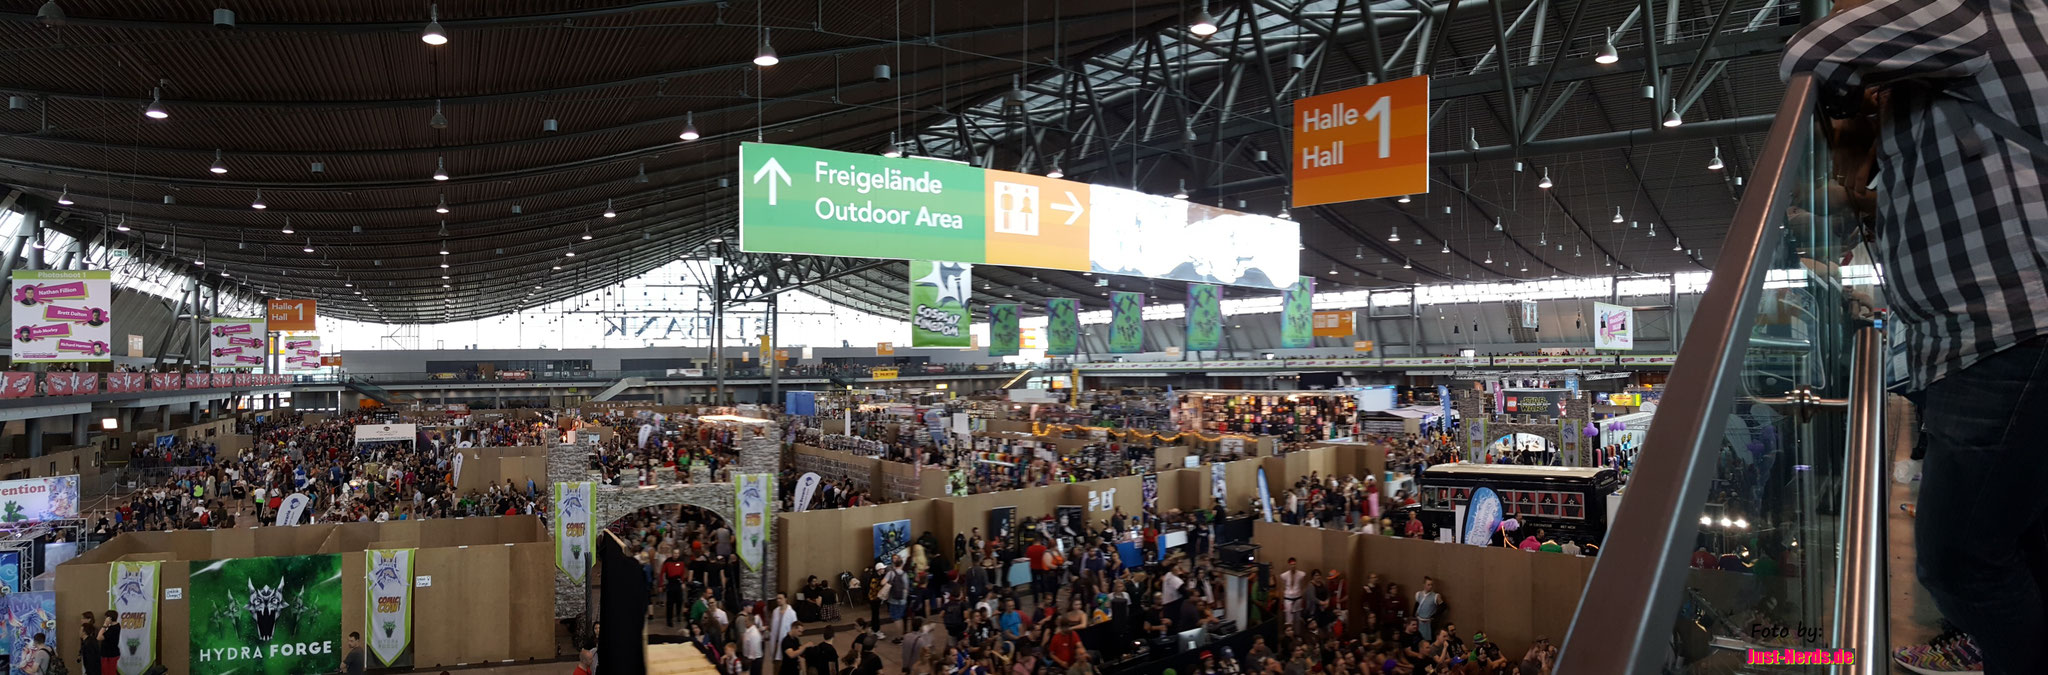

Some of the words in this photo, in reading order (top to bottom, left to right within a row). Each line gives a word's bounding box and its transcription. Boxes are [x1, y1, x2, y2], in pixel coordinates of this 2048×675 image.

[1303, 103, 1359, 133] Halle
[1363, 95, 1391, 159] 1
[1302, 140, 1344, 170] Hall
[814, 160, 943, 198] Freigelände
[814, 196, 911, 227] Outdoor
[915, 206, 964, 231] Area
[70, 310, 88, 318] Dalton
[271, 302, 293, 312] Halle
[271, 312, 288, 322] Hall
[293, 302, 305, 321] 1
[916, 303, 961, 325] COSPLAY
[913, 314, 960, 337] KINGDOM
[1520, 404, 1549, 413] WARS
[1522, 396, 1548, 404] STAR
[0, 484, 46, 496] ention
[199, 645, 263, 662] HYDRA
[269, 640, 332, 659] FORGE
